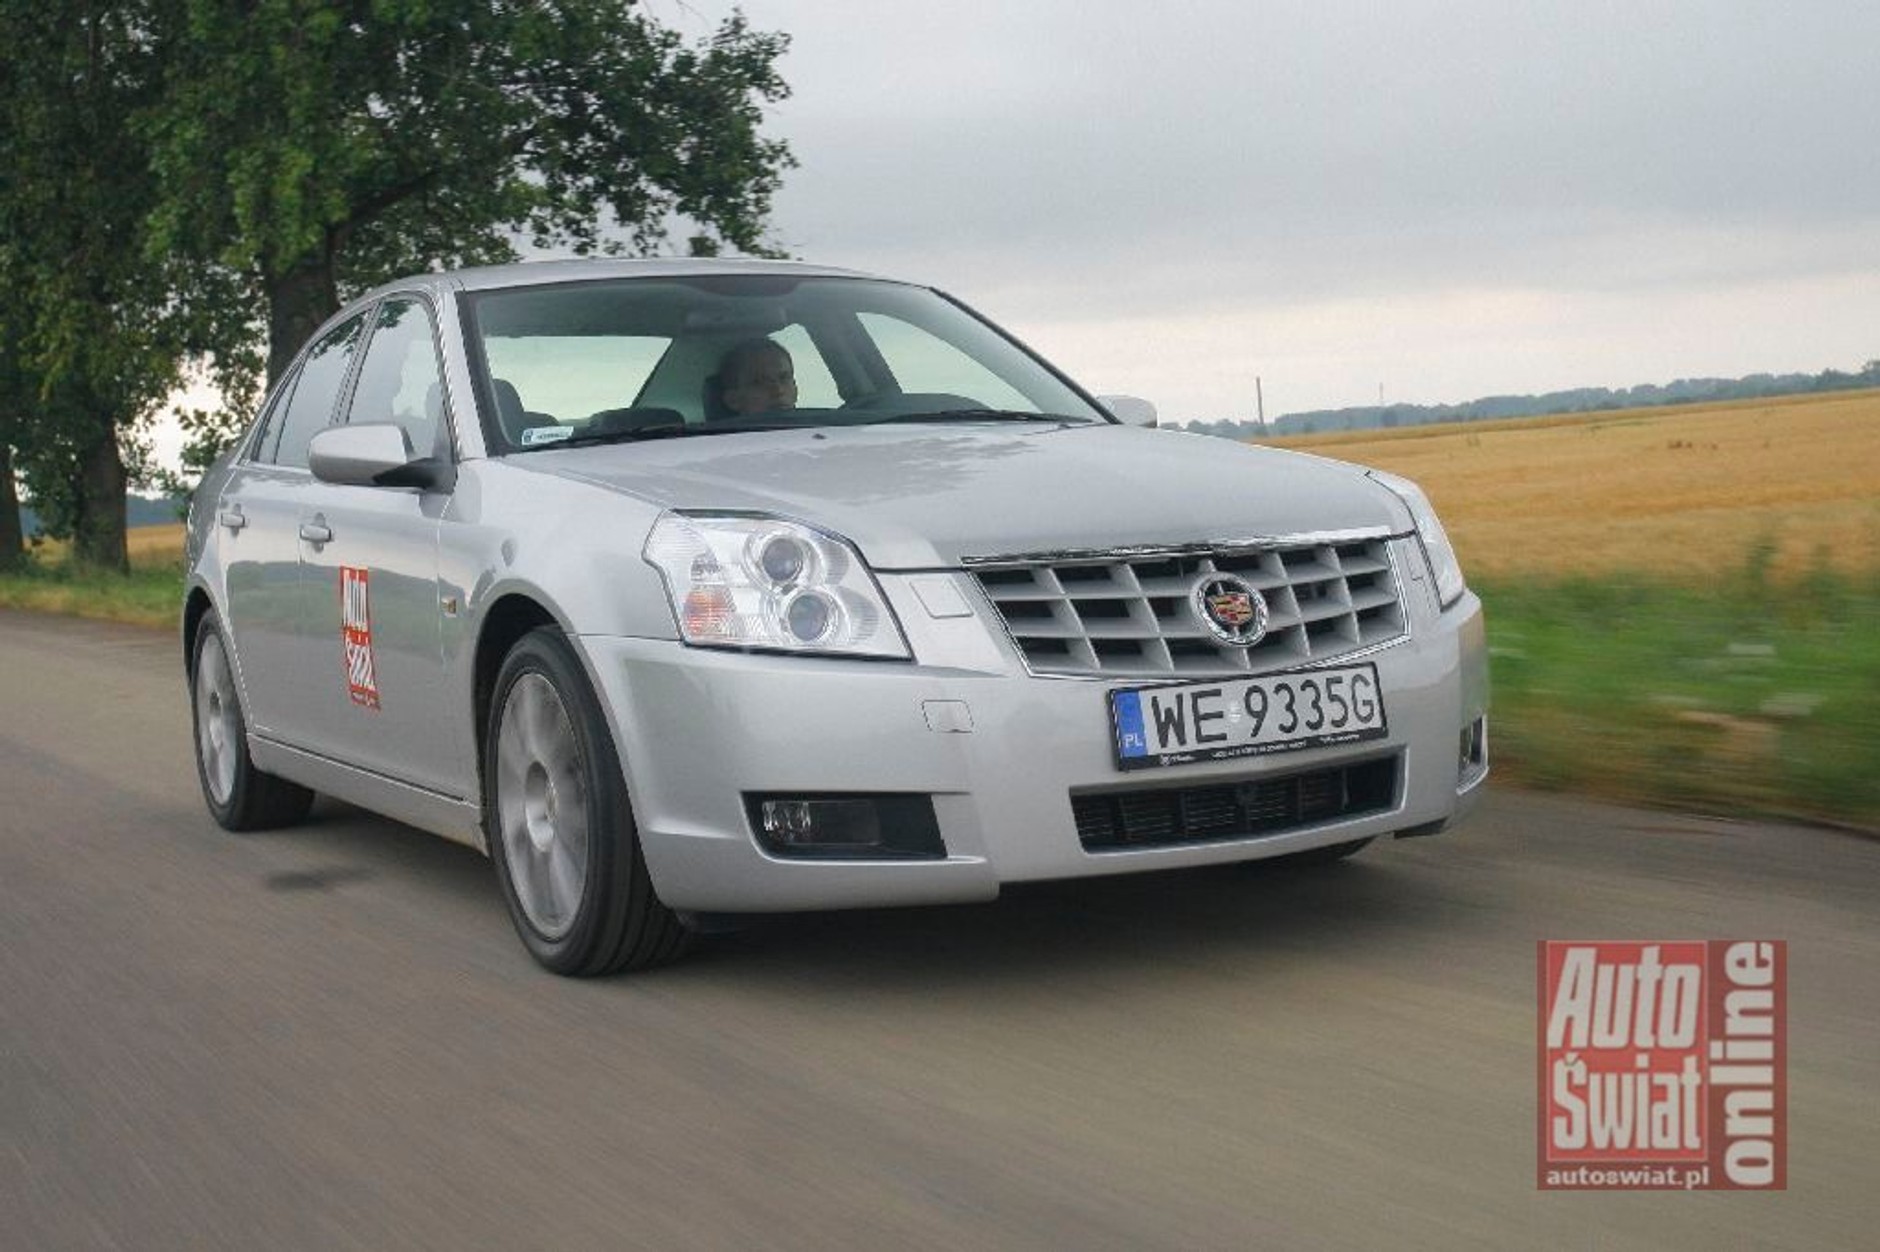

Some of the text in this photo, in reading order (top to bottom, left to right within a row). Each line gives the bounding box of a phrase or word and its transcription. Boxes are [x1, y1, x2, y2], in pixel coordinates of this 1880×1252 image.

[1151, 673, 1375, 749] WE 9335G
[1123, 733, 1144, 748] PL
